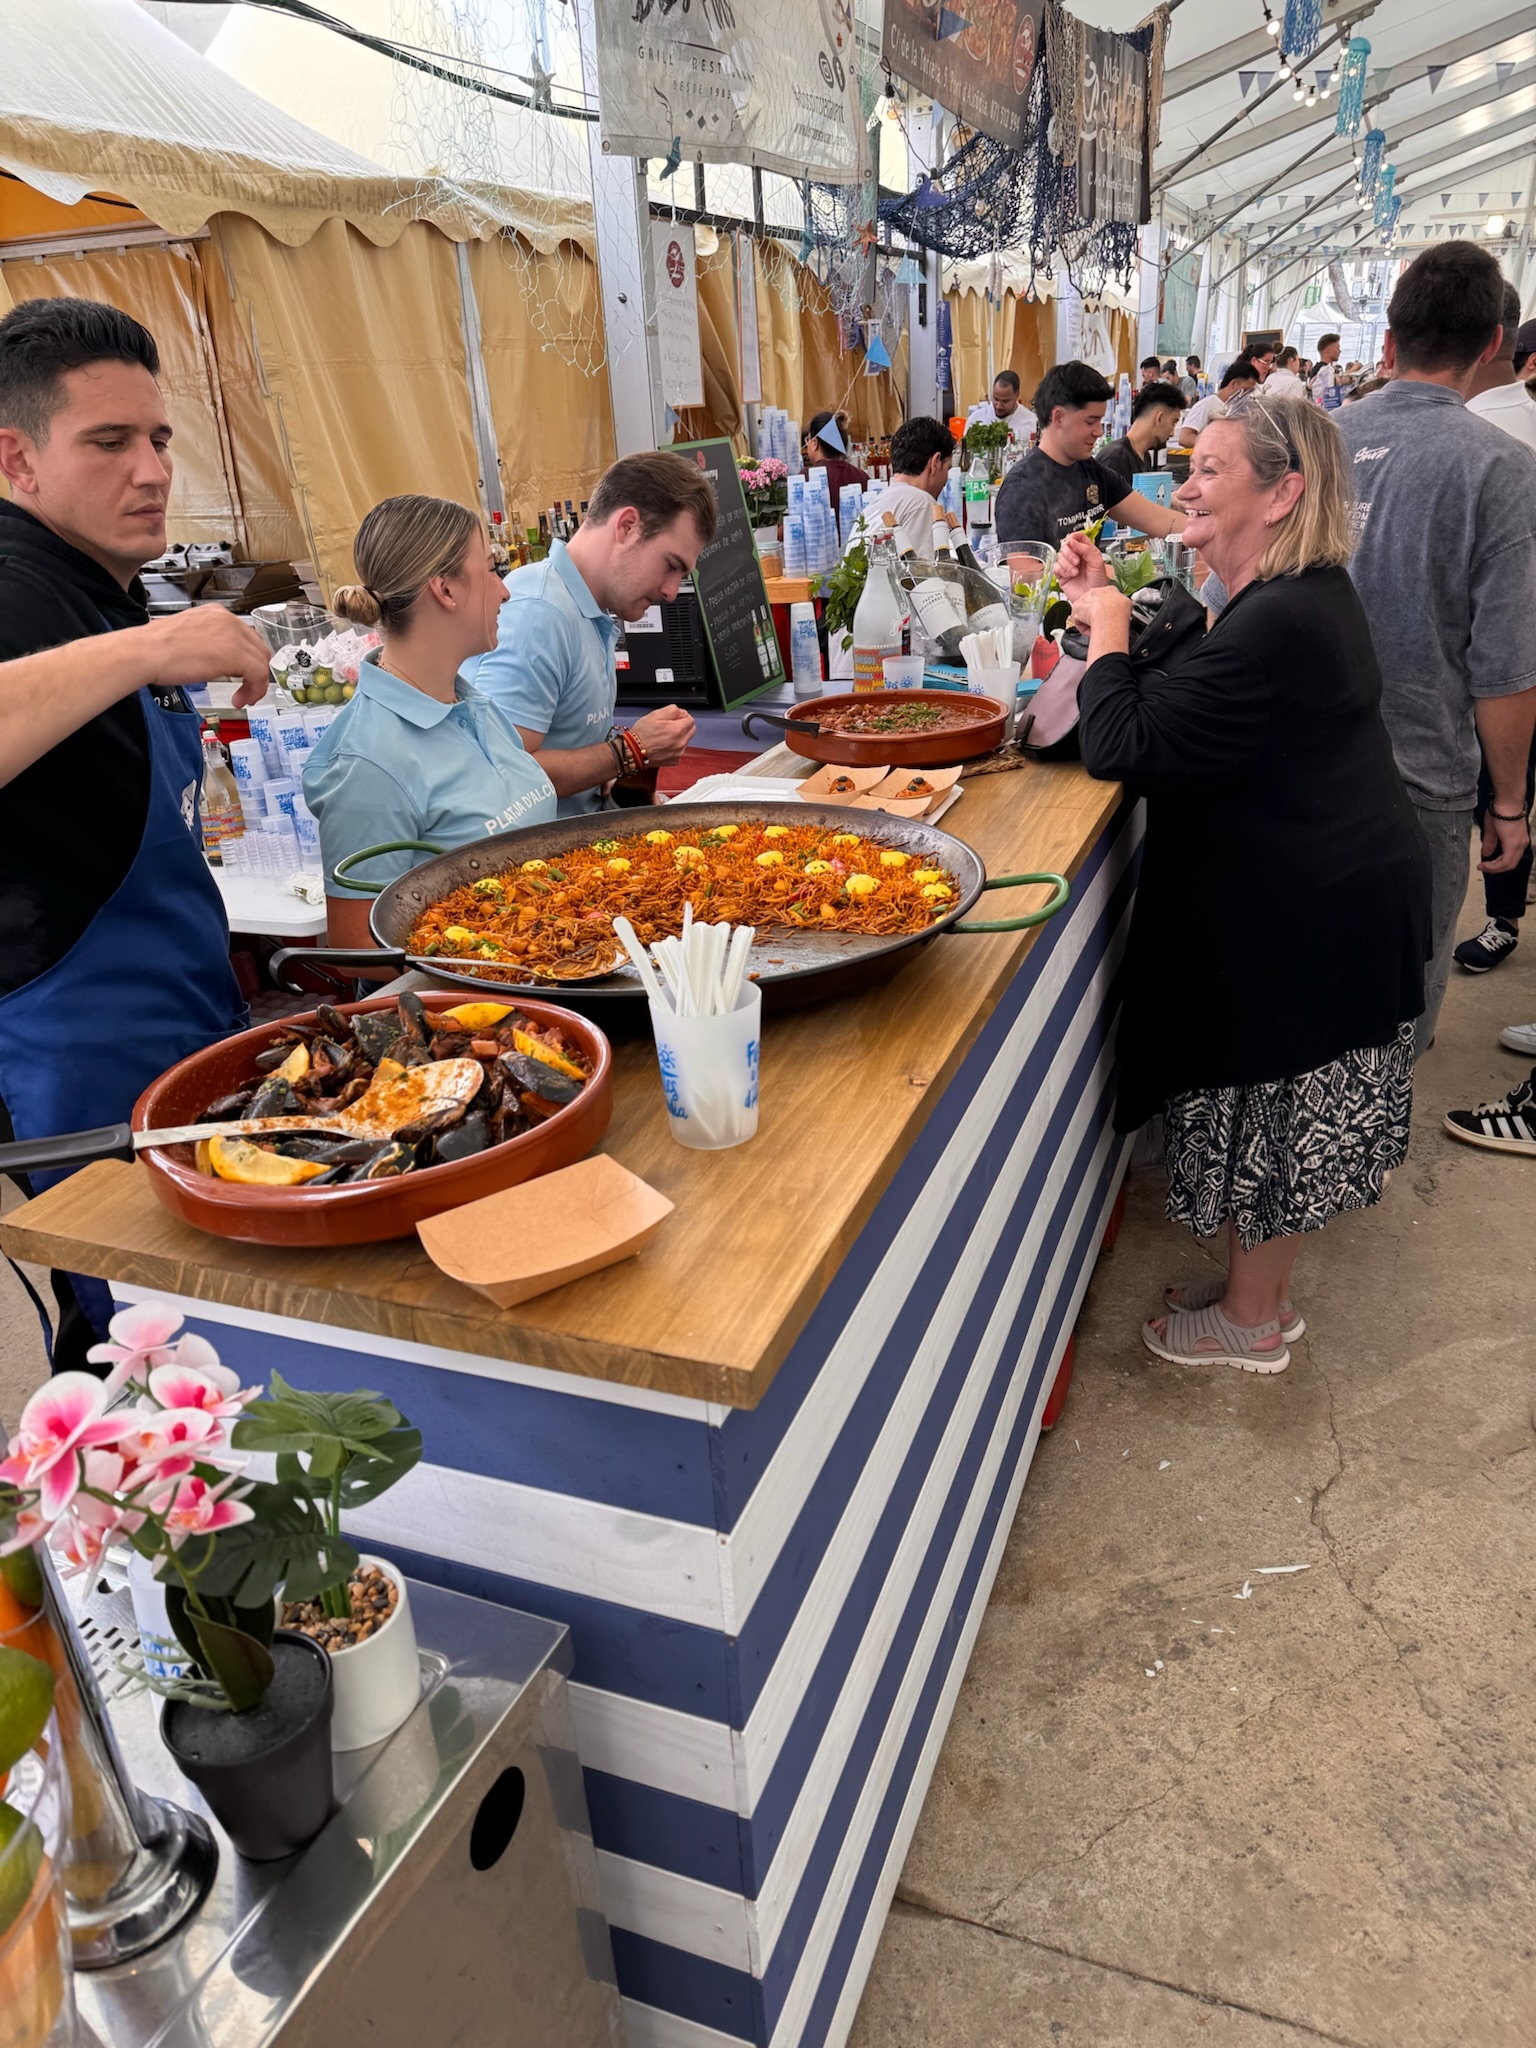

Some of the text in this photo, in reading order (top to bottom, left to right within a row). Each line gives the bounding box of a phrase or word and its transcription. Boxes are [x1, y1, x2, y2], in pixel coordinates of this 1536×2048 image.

[638, 45, 757, 86] GRILL RESTURANT
[673, 80, 731, 100] DESDE 1983
[484, 800, 528, 836] PLATJA
